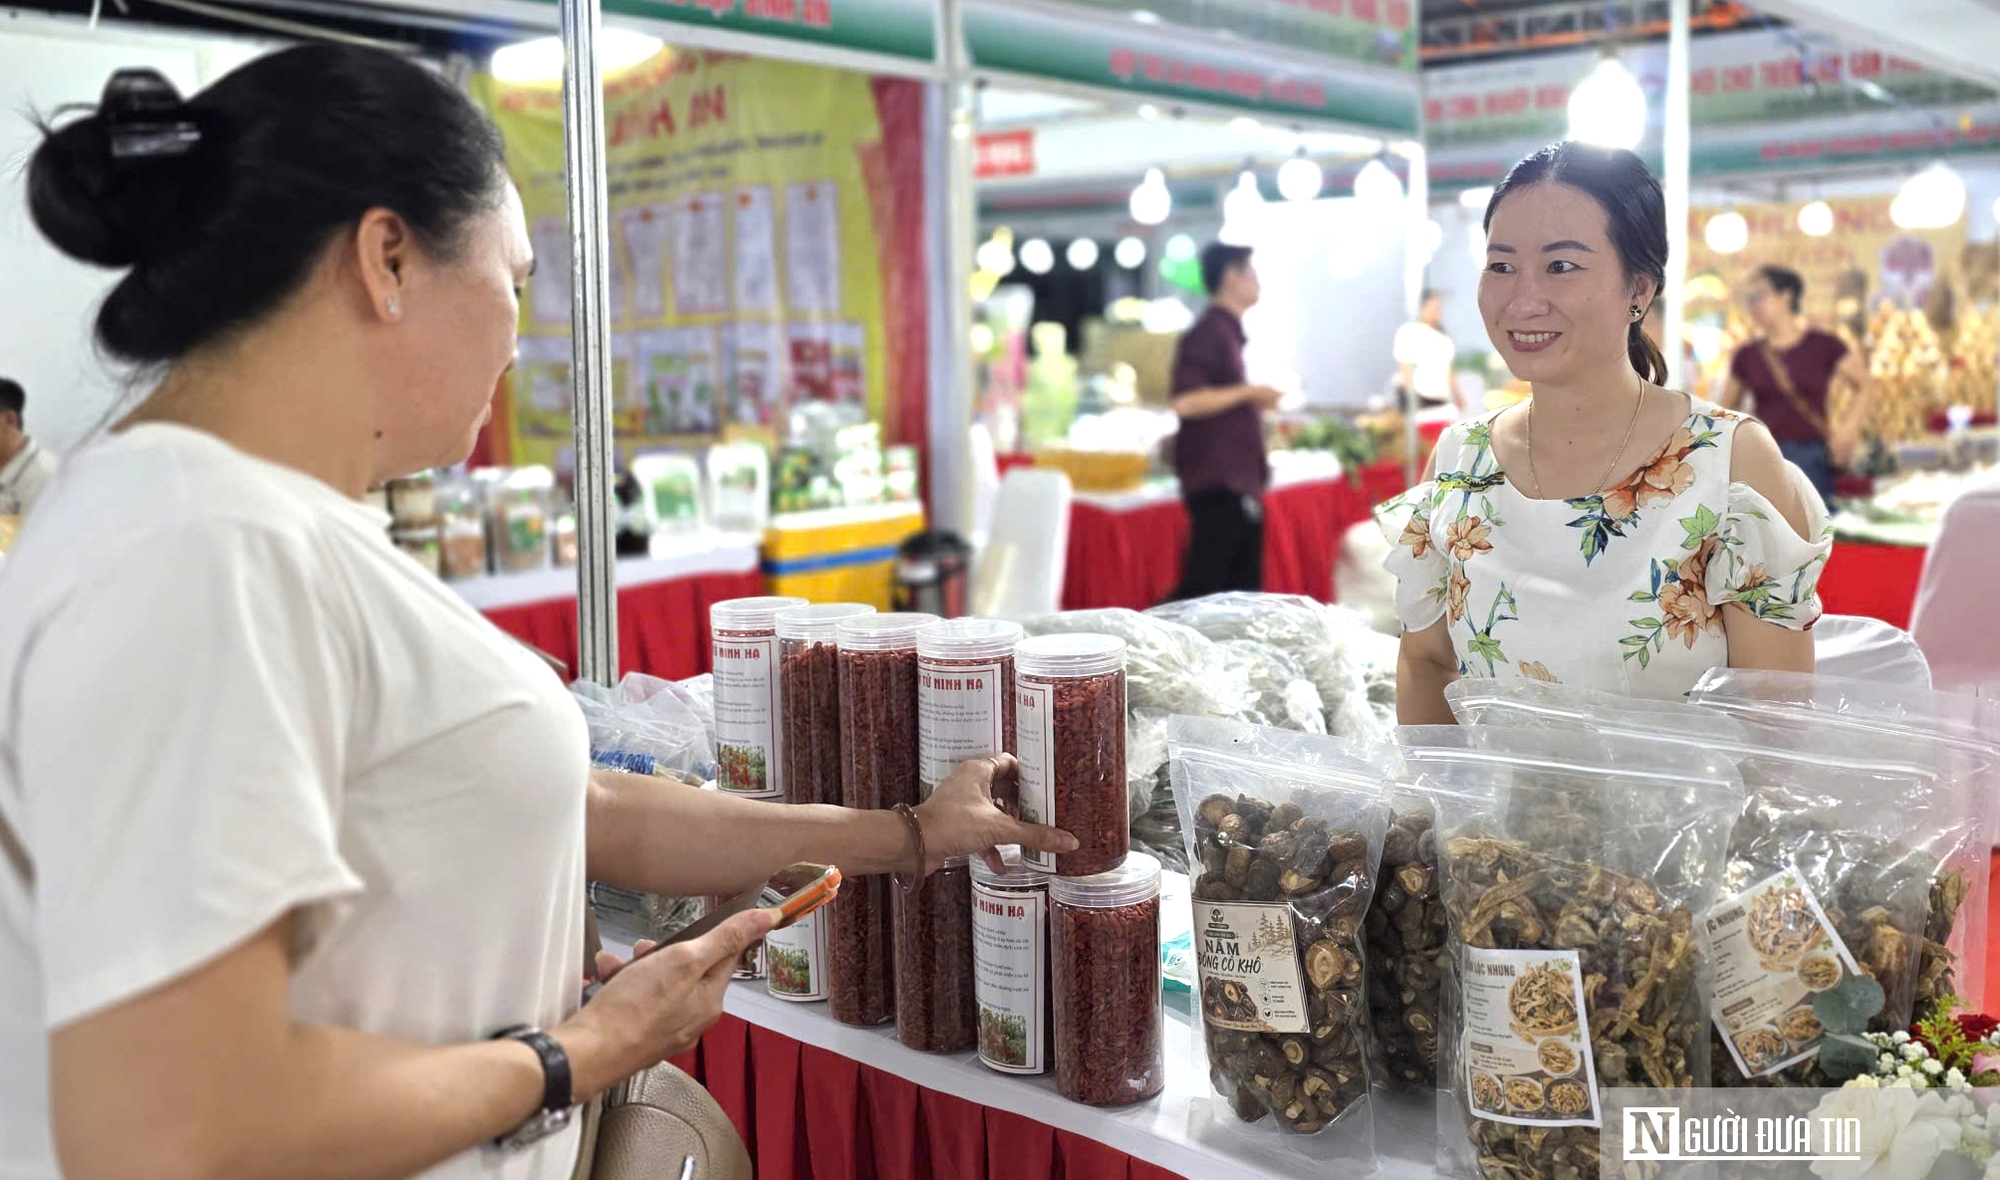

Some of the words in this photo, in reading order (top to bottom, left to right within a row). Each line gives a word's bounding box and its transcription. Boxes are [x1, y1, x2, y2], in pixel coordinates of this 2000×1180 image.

[720, 647, 740, 659] NINH
[745, 648, 760, 660] HẠ
[934, 678, 962, 690] NINH
[966, 677, 983, 692] HẠ
[980, 898, 1004, 916] NINH
[1008, 905, 1025, 920] HẠ
[1237, 956, 1261, 974] KHÔ
[1487, 964, 1516, 977] NHUNG
